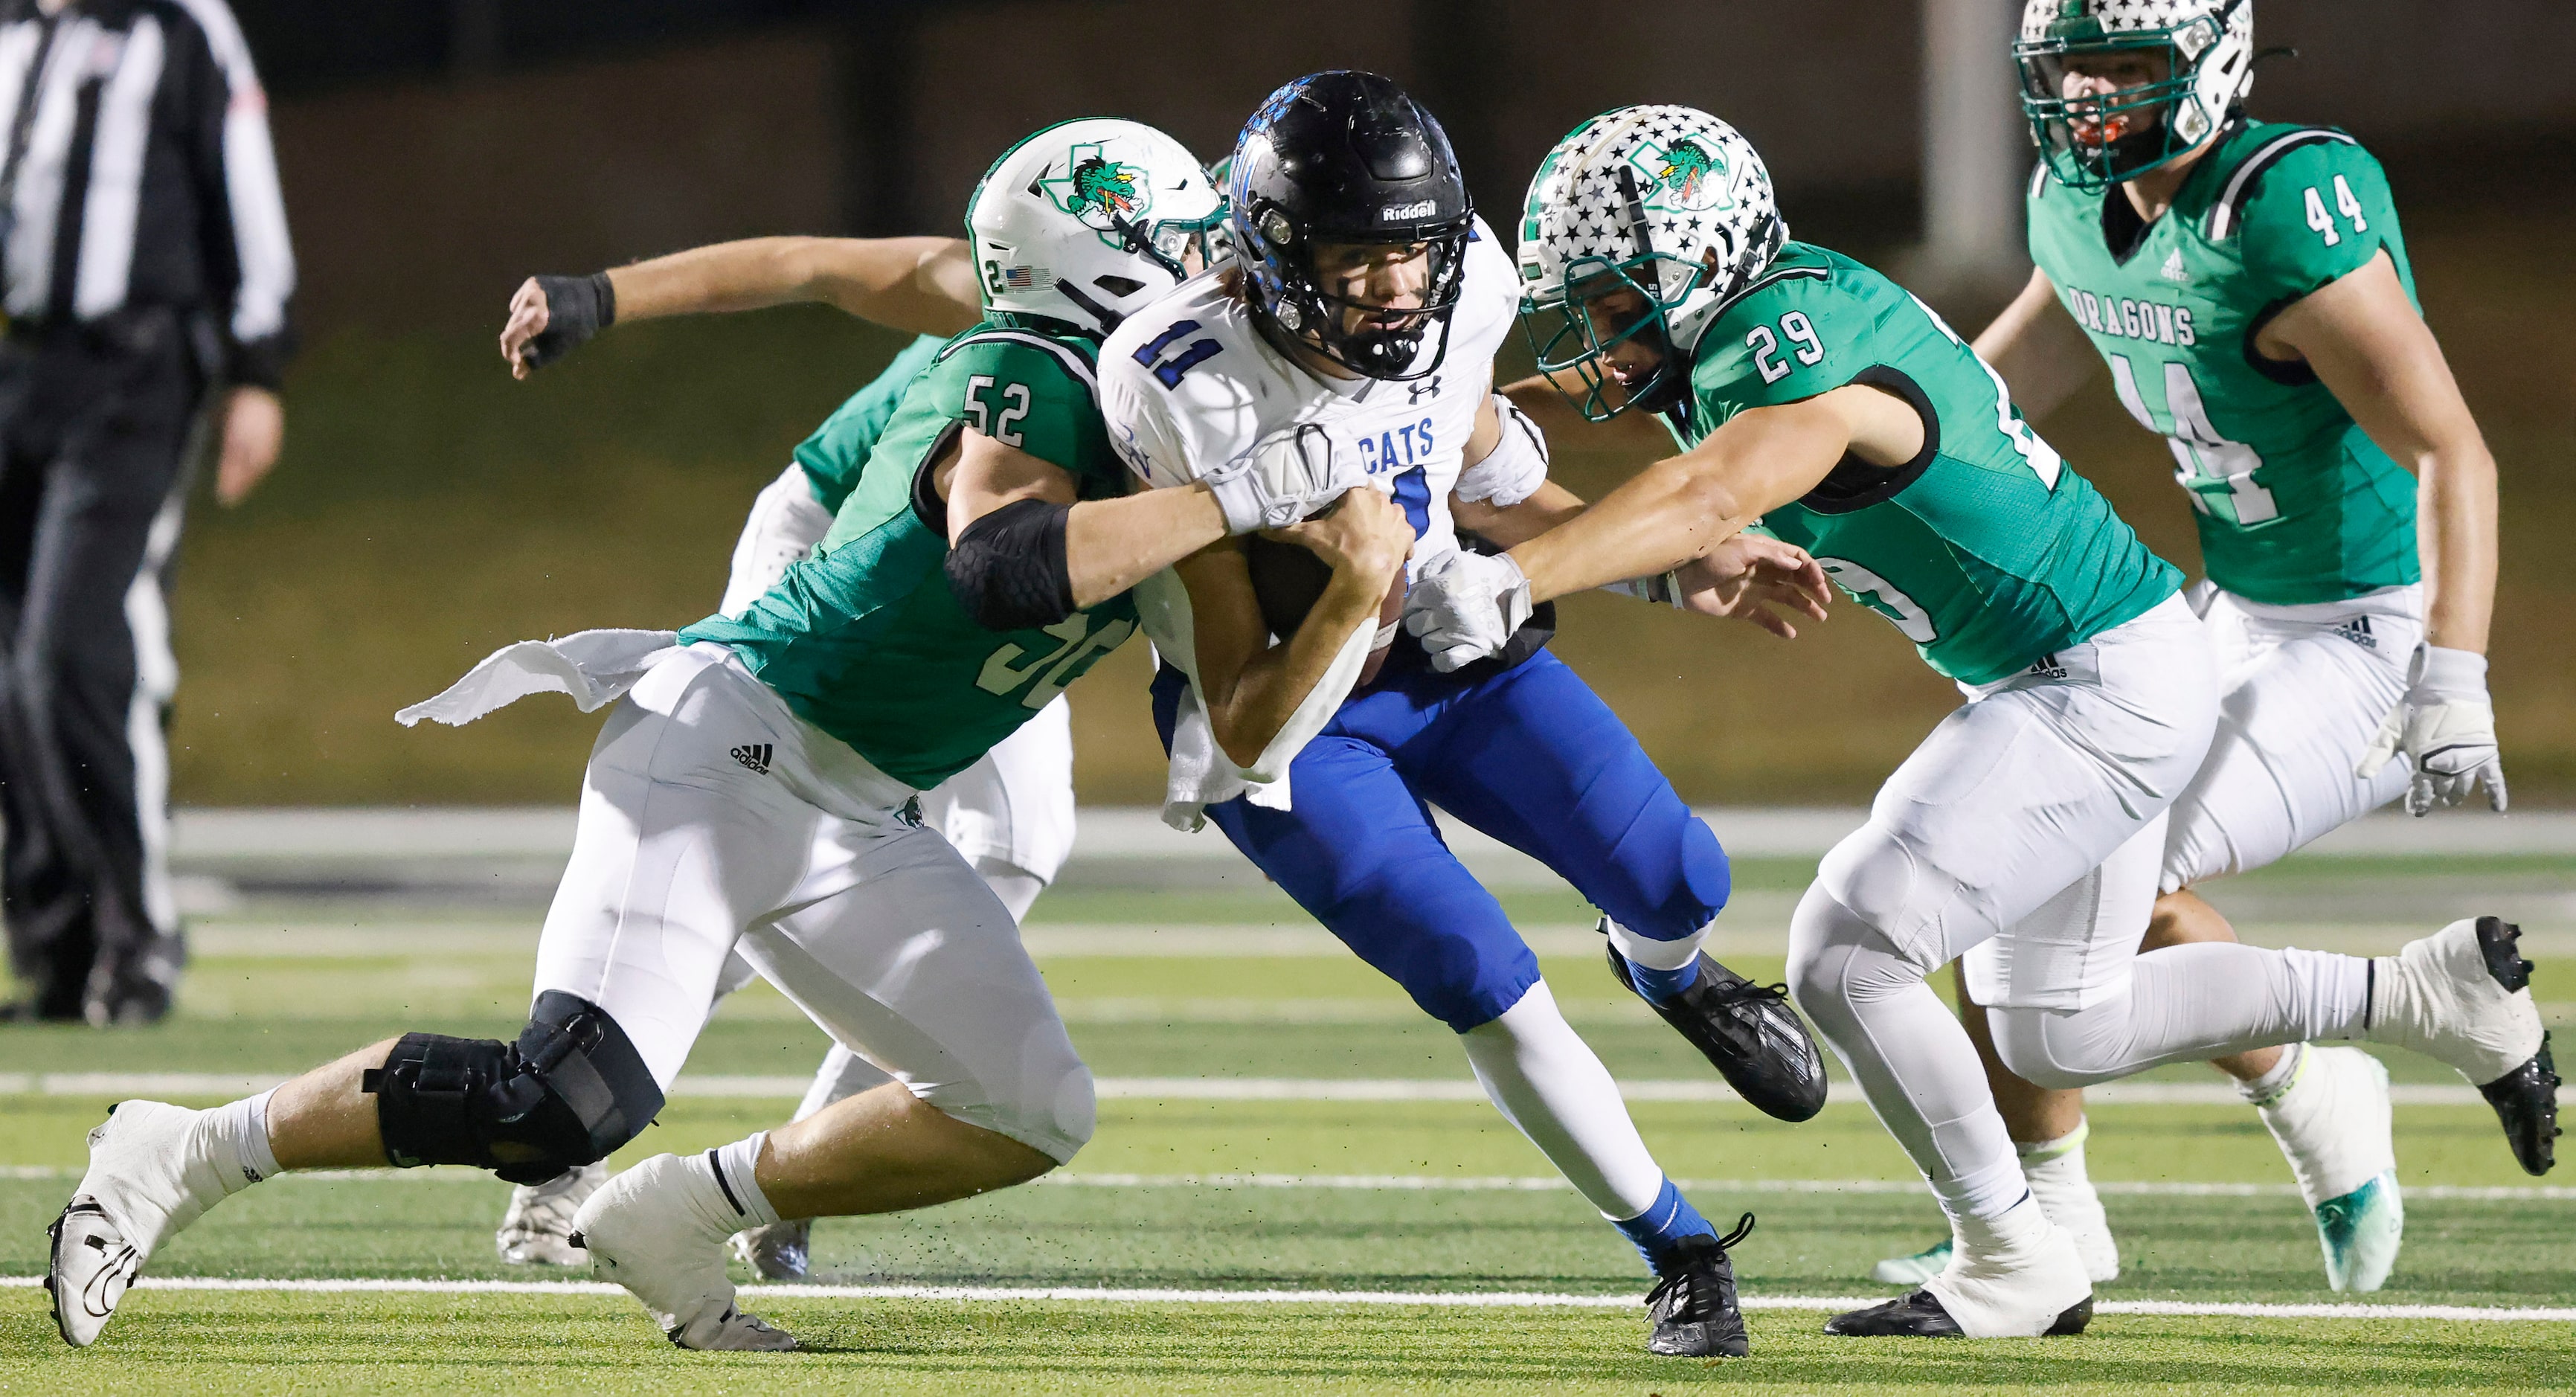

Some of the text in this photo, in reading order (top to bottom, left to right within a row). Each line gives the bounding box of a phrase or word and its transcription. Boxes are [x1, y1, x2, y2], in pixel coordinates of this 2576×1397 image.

[1383, 199, 1436, 221] Riddell
[2303, 173, 2368, 247] 44
[985, 260, 1003, 293] 2
[1745, 310, 1825, 385] 29
[2068, 286, 2195, 347] DRAGONS
[1131, 319, 1224, 391] 11
[963, 374, 1030, 448] 52
[2110, 353, 2279, 525] 44
[1358, 417, 1433, 475] CATS
[730, 748, 769, 776] adidas
